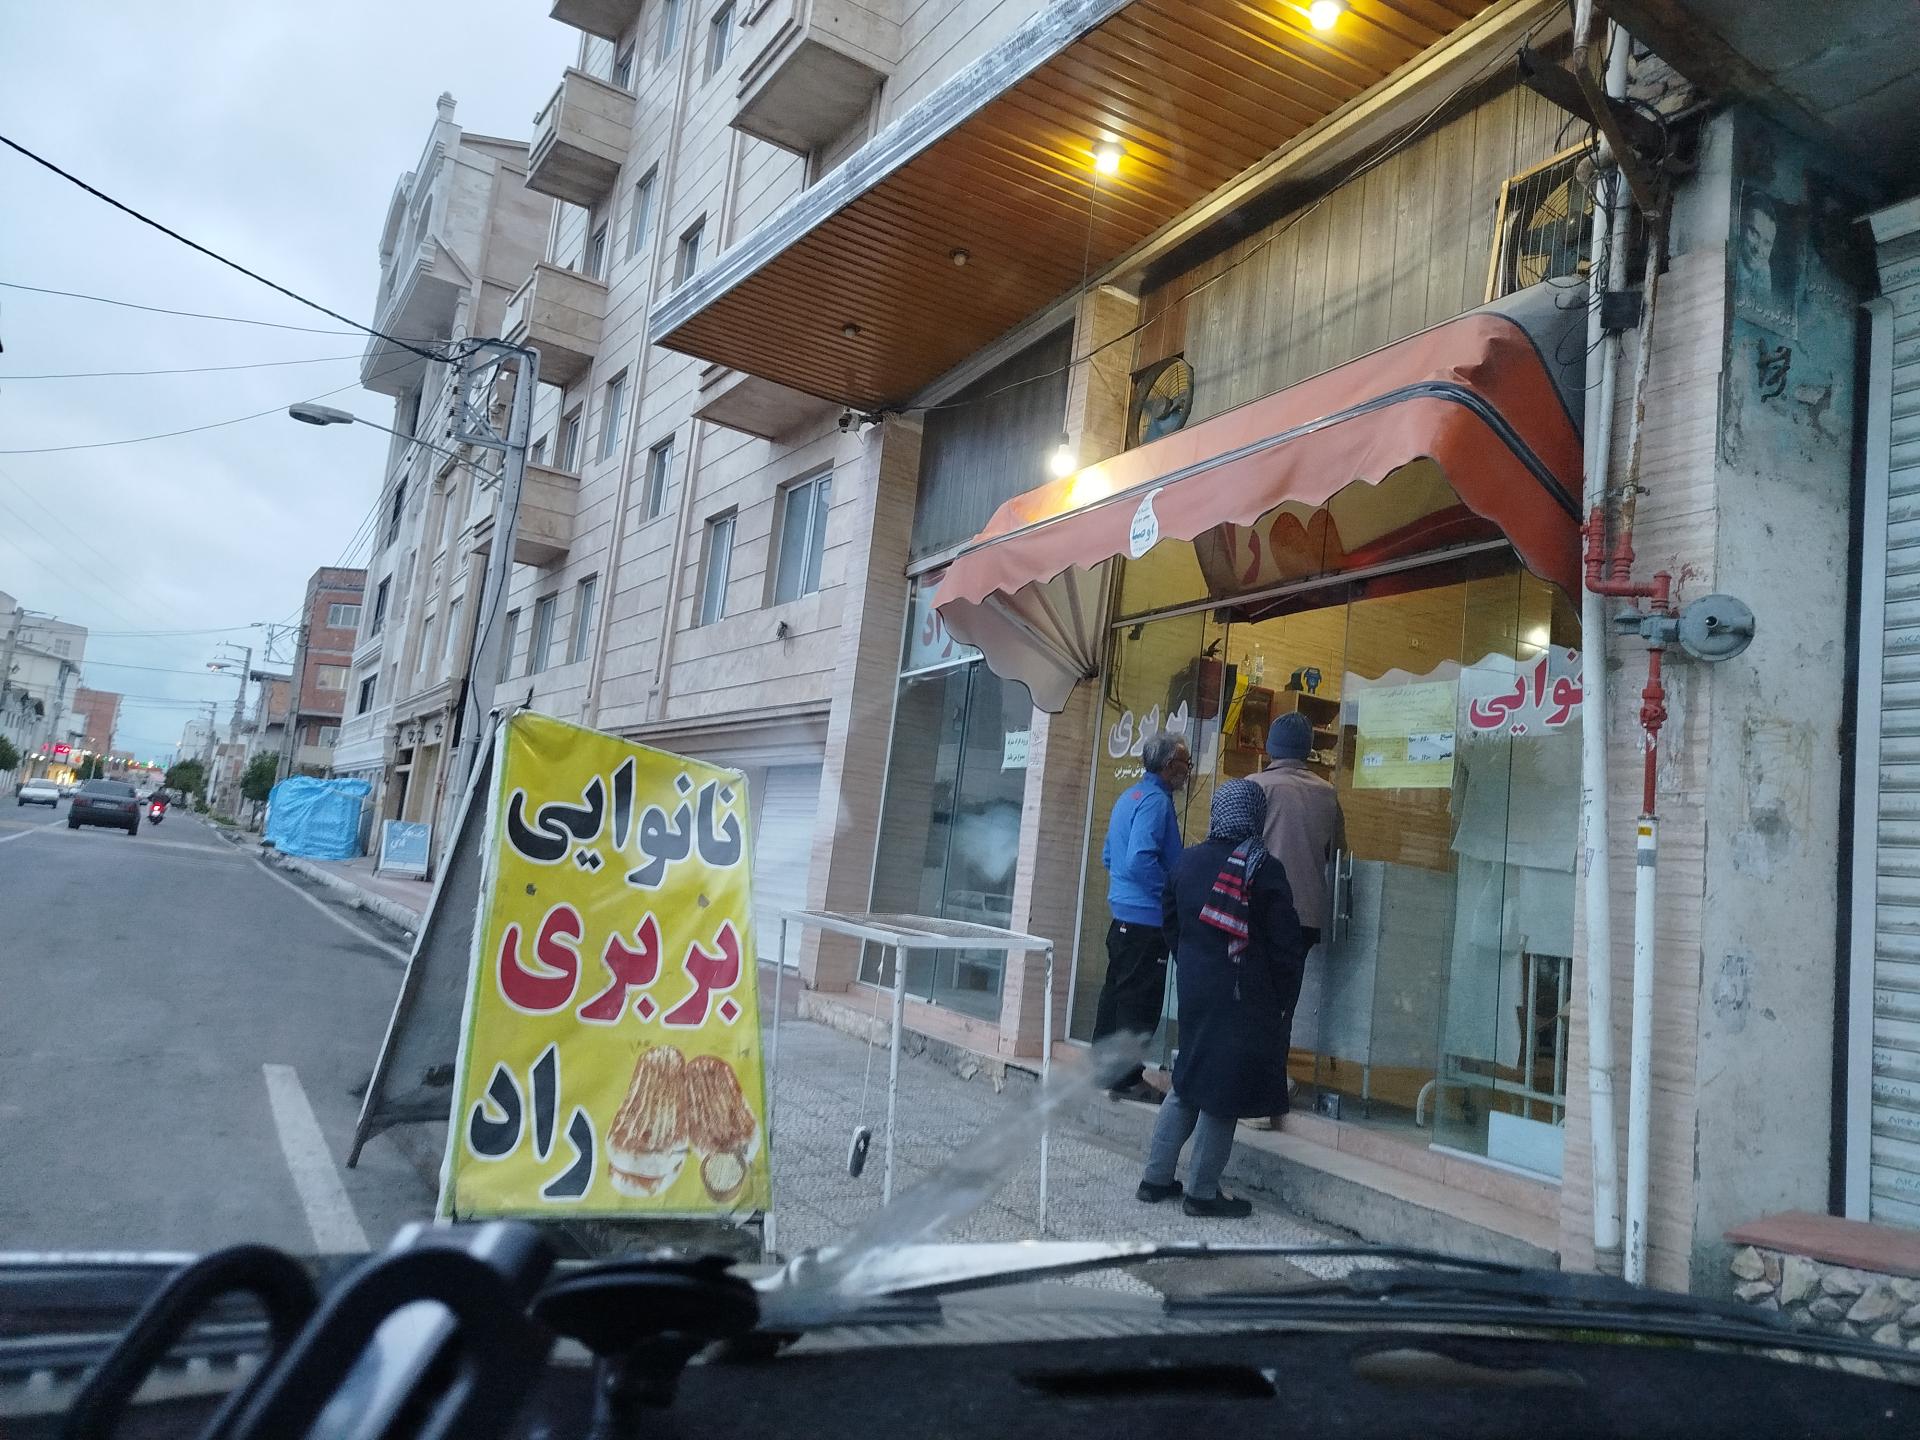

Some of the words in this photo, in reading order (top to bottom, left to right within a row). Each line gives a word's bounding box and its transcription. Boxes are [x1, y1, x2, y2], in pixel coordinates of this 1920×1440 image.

[504, 755, 743, 890] نانوایی
[496, 902, 744, 1031] بربری
[468, 1040, 597, 1202] راد
